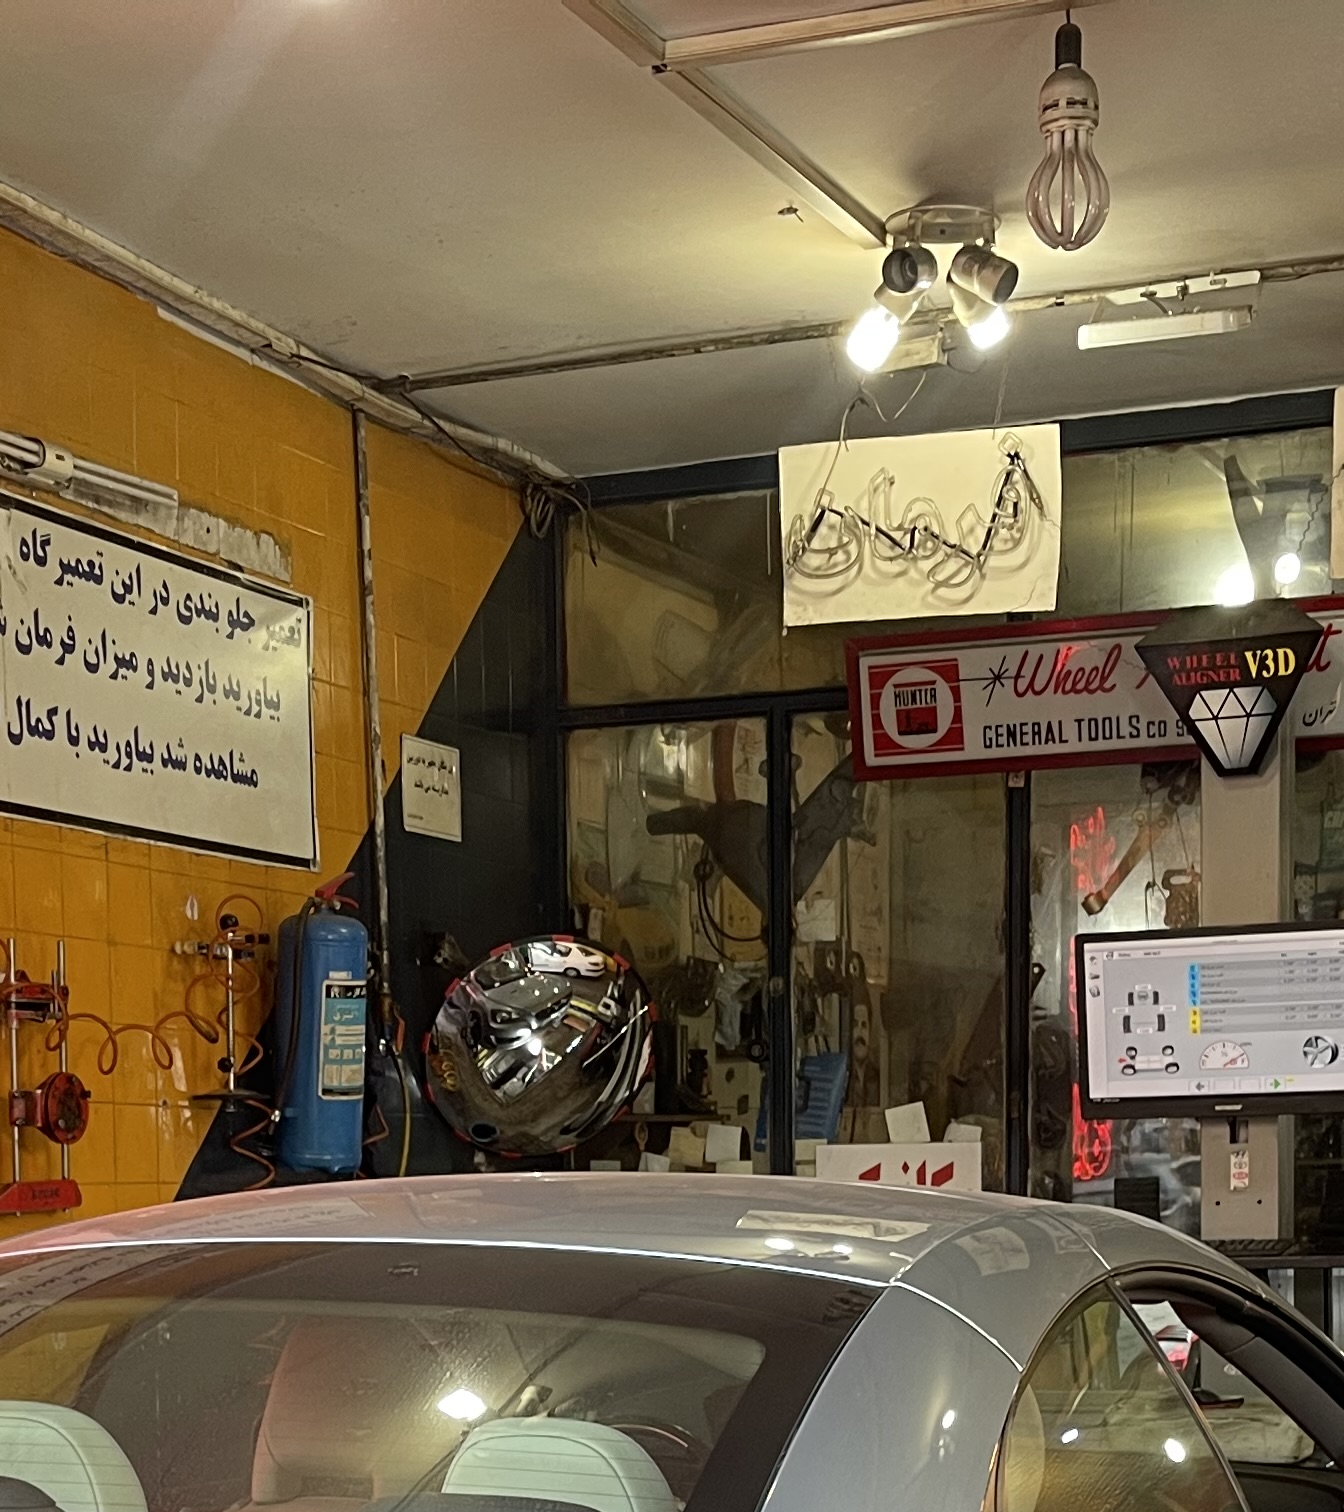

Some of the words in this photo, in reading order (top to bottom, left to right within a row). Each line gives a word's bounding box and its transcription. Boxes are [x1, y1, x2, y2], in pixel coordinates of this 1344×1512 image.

[111, 563, 142, 607] این
[148, 580, 169, 615] در
[177, 592, 219, 633] بندی
[226, 597, 255, 644] جلو
[15, 608, 76, 666] فرمان
[83, 628, 138, 681] میزان
[262, 617, 302, 652] تعمیر
[145, 657, 155, 690] و
[161, 656, 217, 705] بازدید
[1013, 643, 1123, 698] Wheel
[1167, 652, 1239, 670] WHEEL
[1172, 668, 1241, 686] ALIGNER
[1244, 647, 1296, 680] V3D
[223, 672, 281, 722] بیاورید
[894, 686, 938, 708] HUNTER
[7, 695, 58, 745] کمال
[66, 708, 80, 759] با
[983, 720, 1069, 749] GENERAL
[1074, 714, 1141, 743] TOOLS
[87, 723, 154, 776] بیاورید
[161, 737, 188, 772] شد
[193, 748, 259, 789] مشاهده
